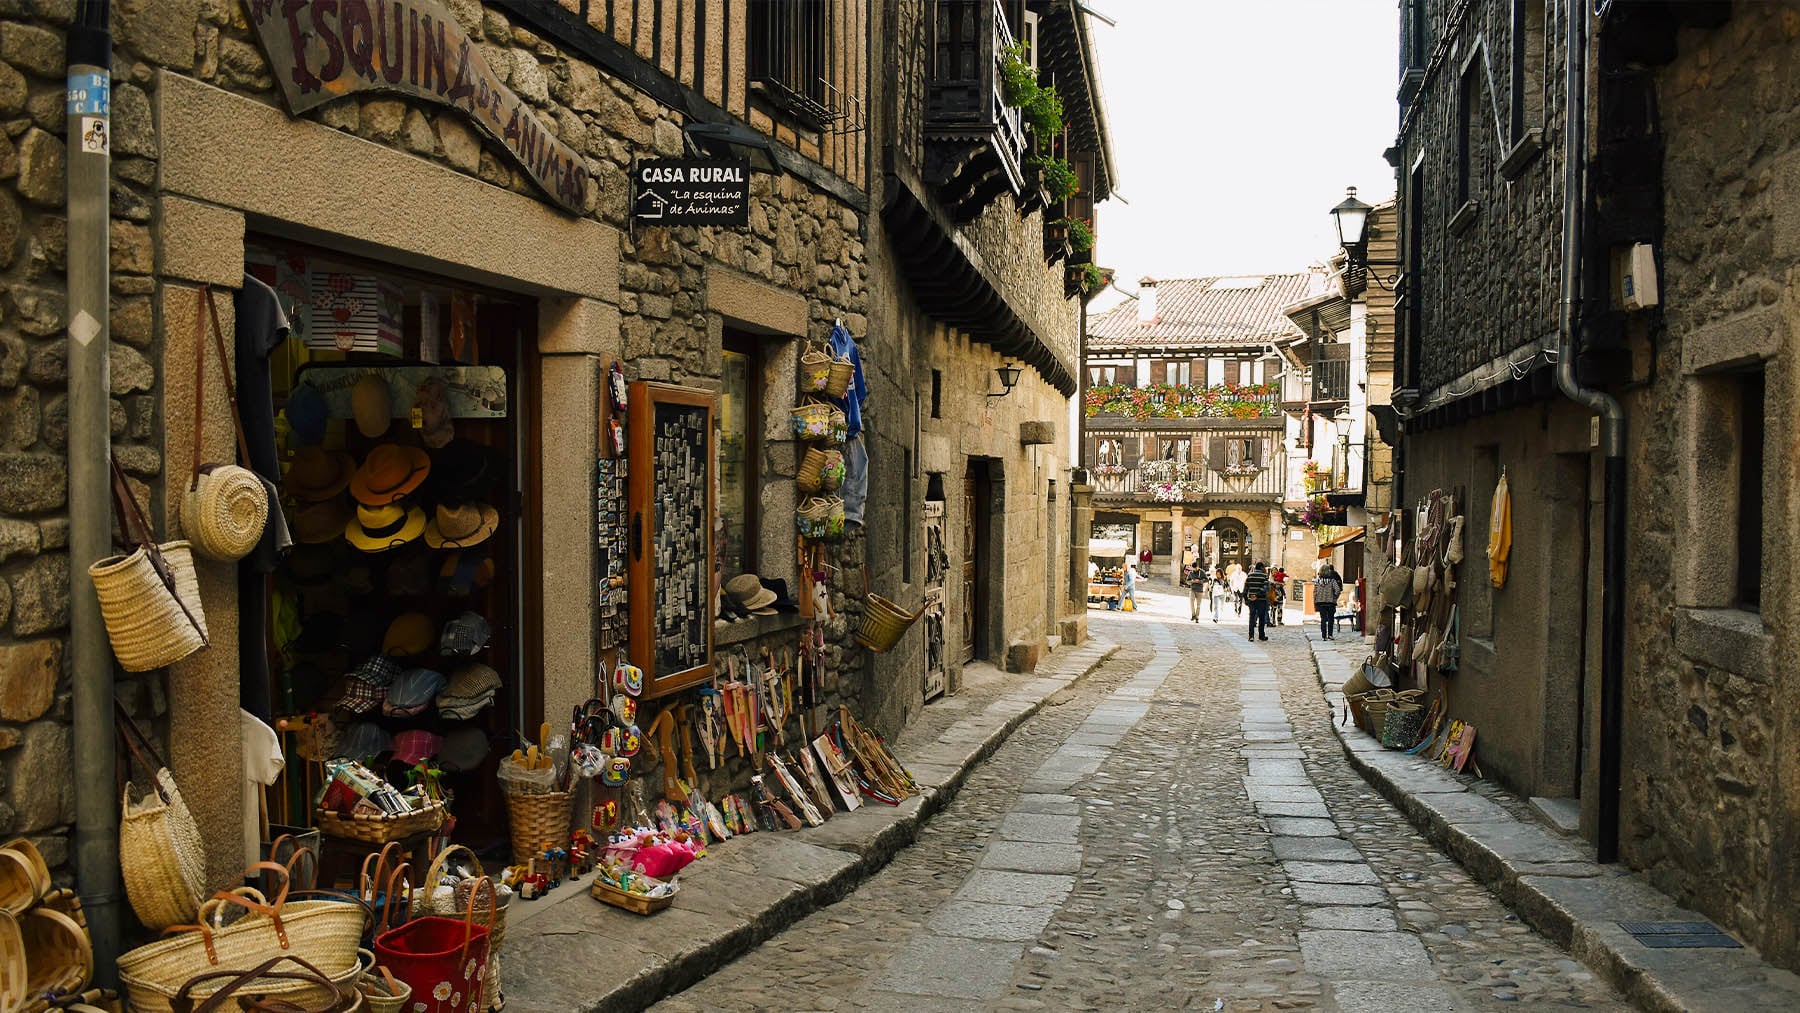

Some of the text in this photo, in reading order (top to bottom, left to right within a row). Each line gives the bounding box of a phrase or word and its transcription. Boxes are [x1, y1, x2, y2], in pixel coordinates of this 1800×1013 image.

[281, 0, 476, 112] ESQUINA
[642, 167, 744, 183] CASA RURAL
[693, 187, 742, 204] esquina
[669, 203, 683, 215] de
